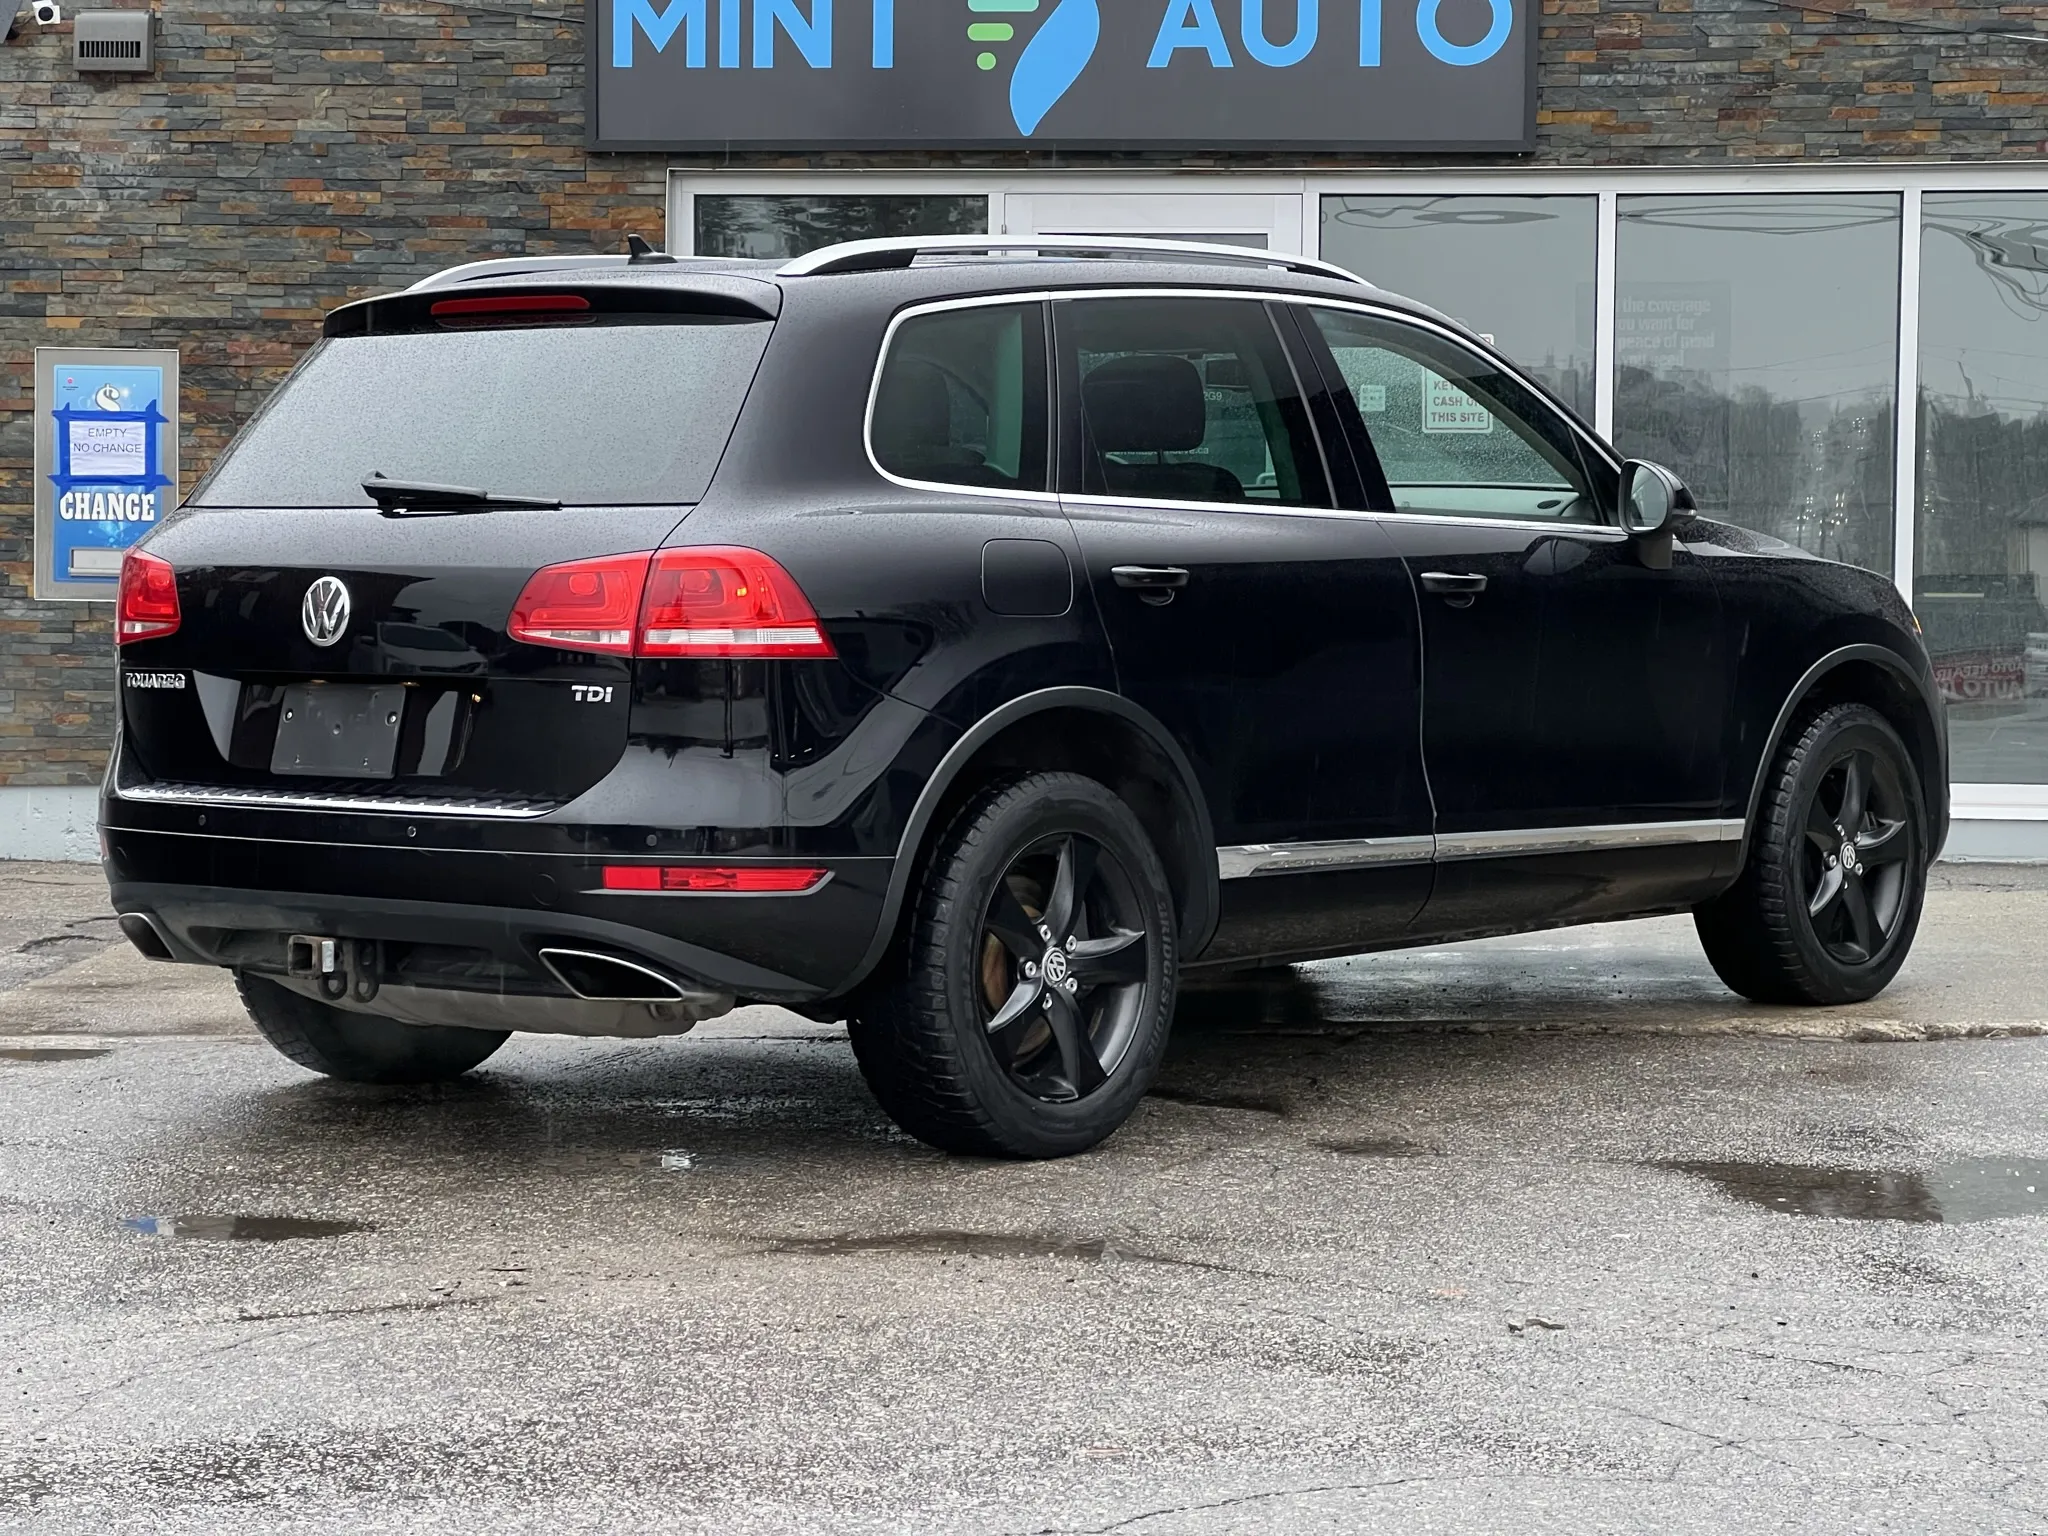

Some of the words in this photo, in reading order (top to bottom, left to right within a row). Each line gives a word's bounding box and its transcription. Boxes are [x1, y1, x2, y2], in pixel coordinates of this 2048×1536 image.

[1623, 296, 1646, 313] the
[1647, 299, 1712, 317] coverage
[1616, 317, 1635, 331] ou
[1638, 317, 1673, 331] want
[1617, 334, 1661, 352] peace
[1663, 331, 1678, 349] of
[1433, 396, 1463, 407] CASH
[1431, 412, 1457, 423] THIS
[1460, 412, 1485, 423] SITE
[88, 428, 127, 438] EMPTY
[73, 443, 90, 453] NO
[92, 443, 142, 453] CHANGE
[59, 491, 155, 522] CHANGE
[125, 672, 186, 689] TOUAREG
[571, 685, 613, 703] TDI
